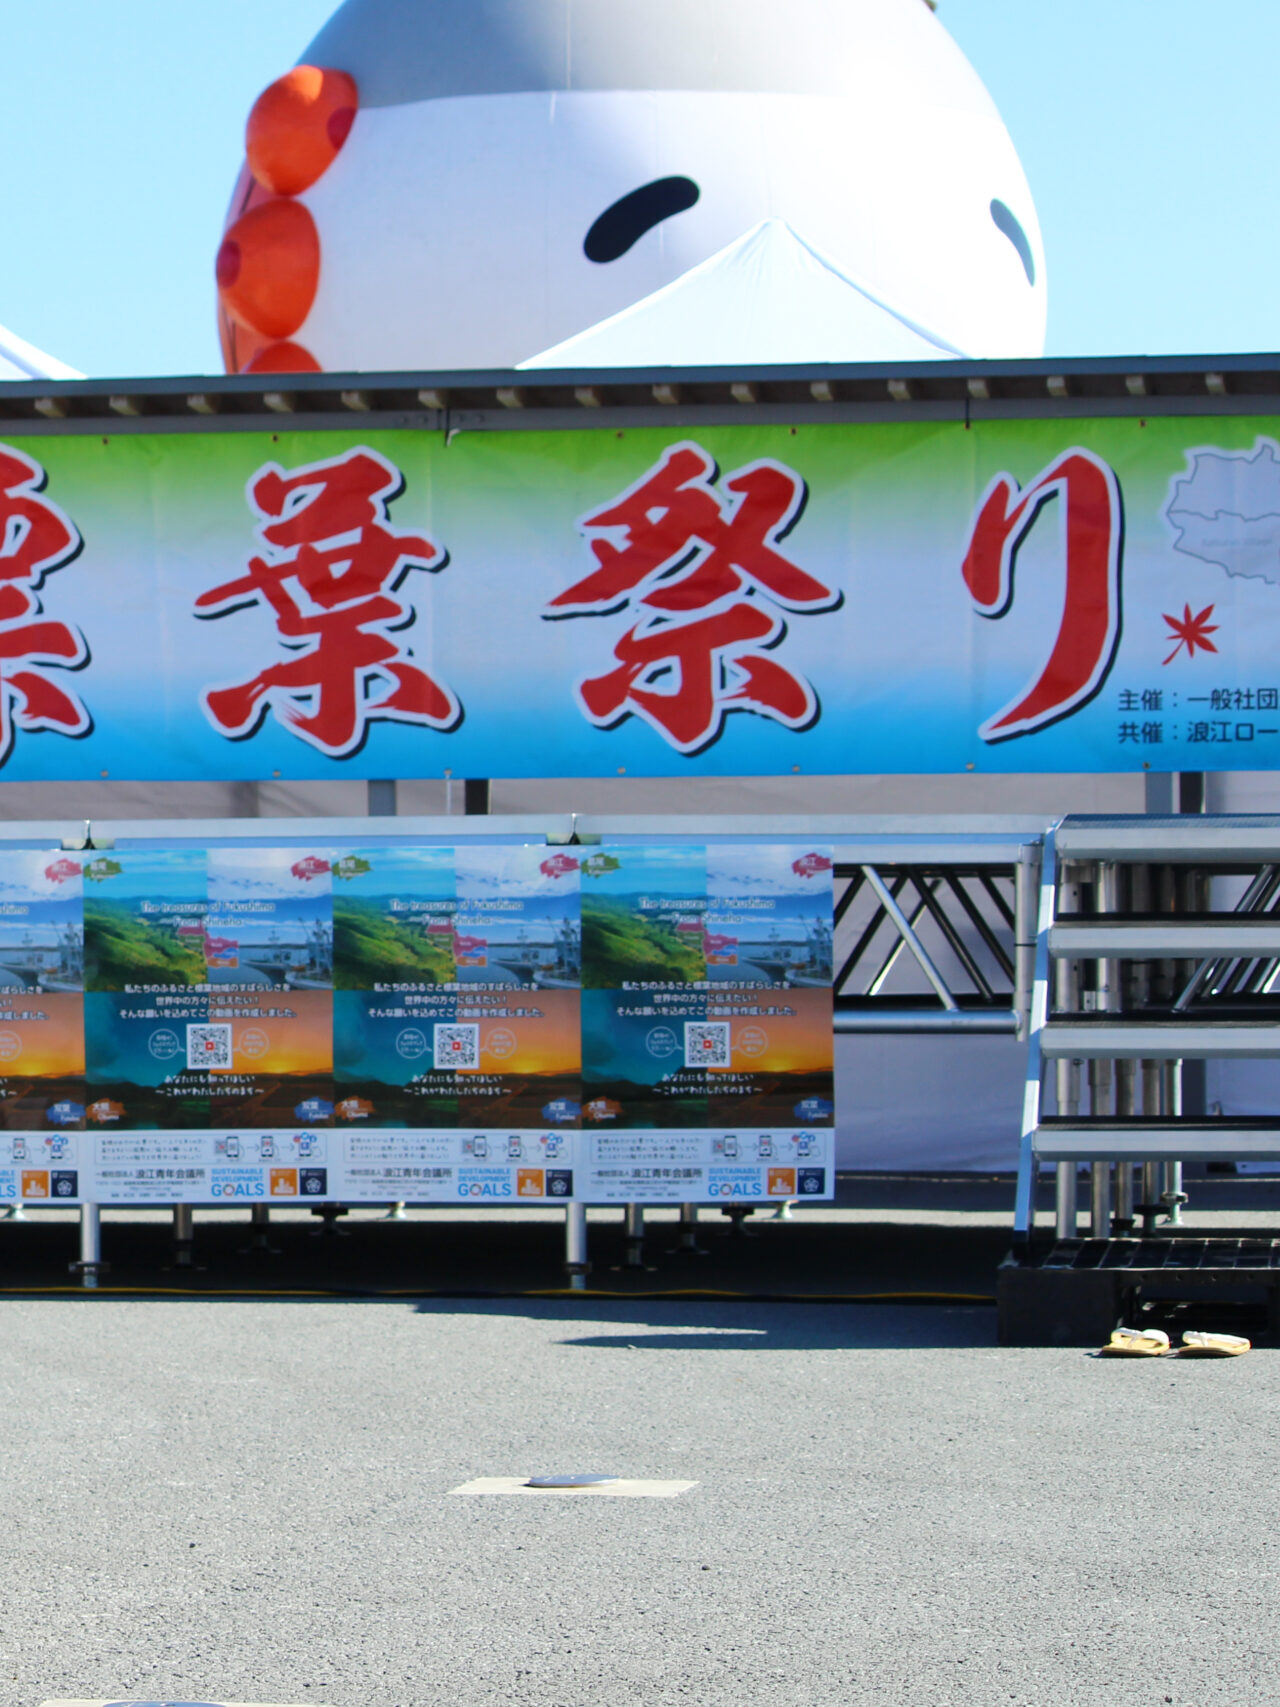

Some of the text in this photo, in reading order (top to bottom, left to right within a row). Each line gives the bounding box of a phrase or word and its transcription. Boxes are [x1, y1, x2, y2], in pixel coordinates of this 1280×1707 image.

[1118, 688, 1279, 711] 主催：一般社団
[1118, 721, 1279, 743] 共催：浪江ロー
[211, 1183, 264, 1197] GOALS
[457, 1183, 512, 1197] GOALS
[707, 1183, 762, 1197] GOALS
